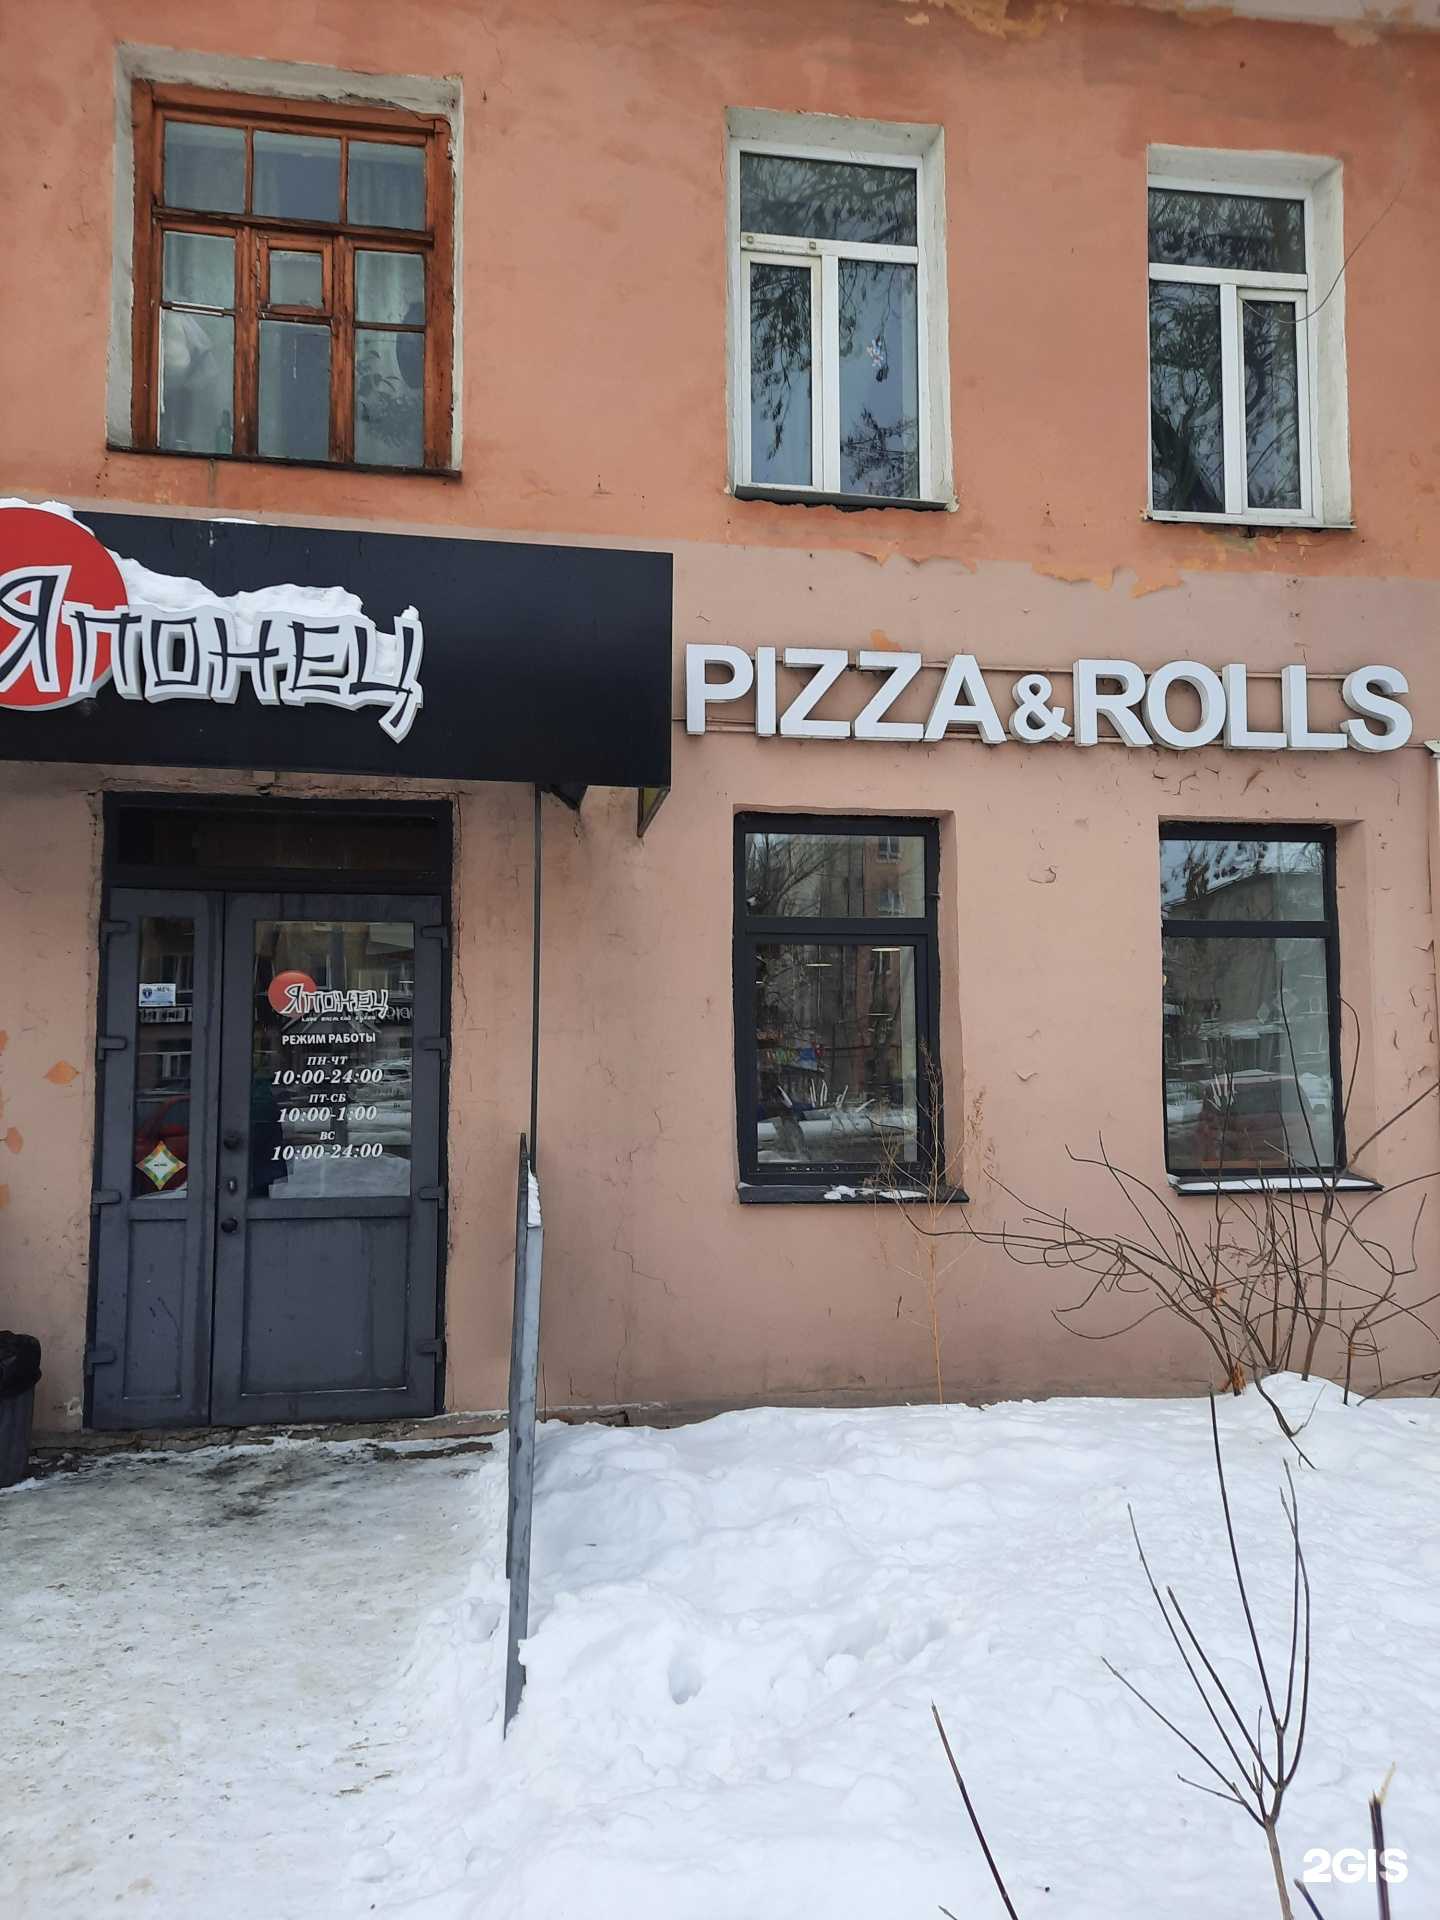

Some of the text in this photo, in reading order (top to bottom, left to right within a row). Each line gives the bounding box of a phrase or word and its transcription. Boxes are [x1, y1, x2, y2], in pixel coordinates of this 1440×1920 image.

[282, 1033, 376, 1045] РЕЖИМ РАБОТЫ
[307, 1056, 348, 1066] ПН-ЧТ
[272, 1069, 383, 1085] 10:00-24:00
[309, 1094, 346, 1103] ПТ-СБ
[277, 1106, 377, 1123] 10:00-1:00
[319, 1132, 335, 1141] ВС
[271, 1144, 383, 1161] 10:00-24:00
